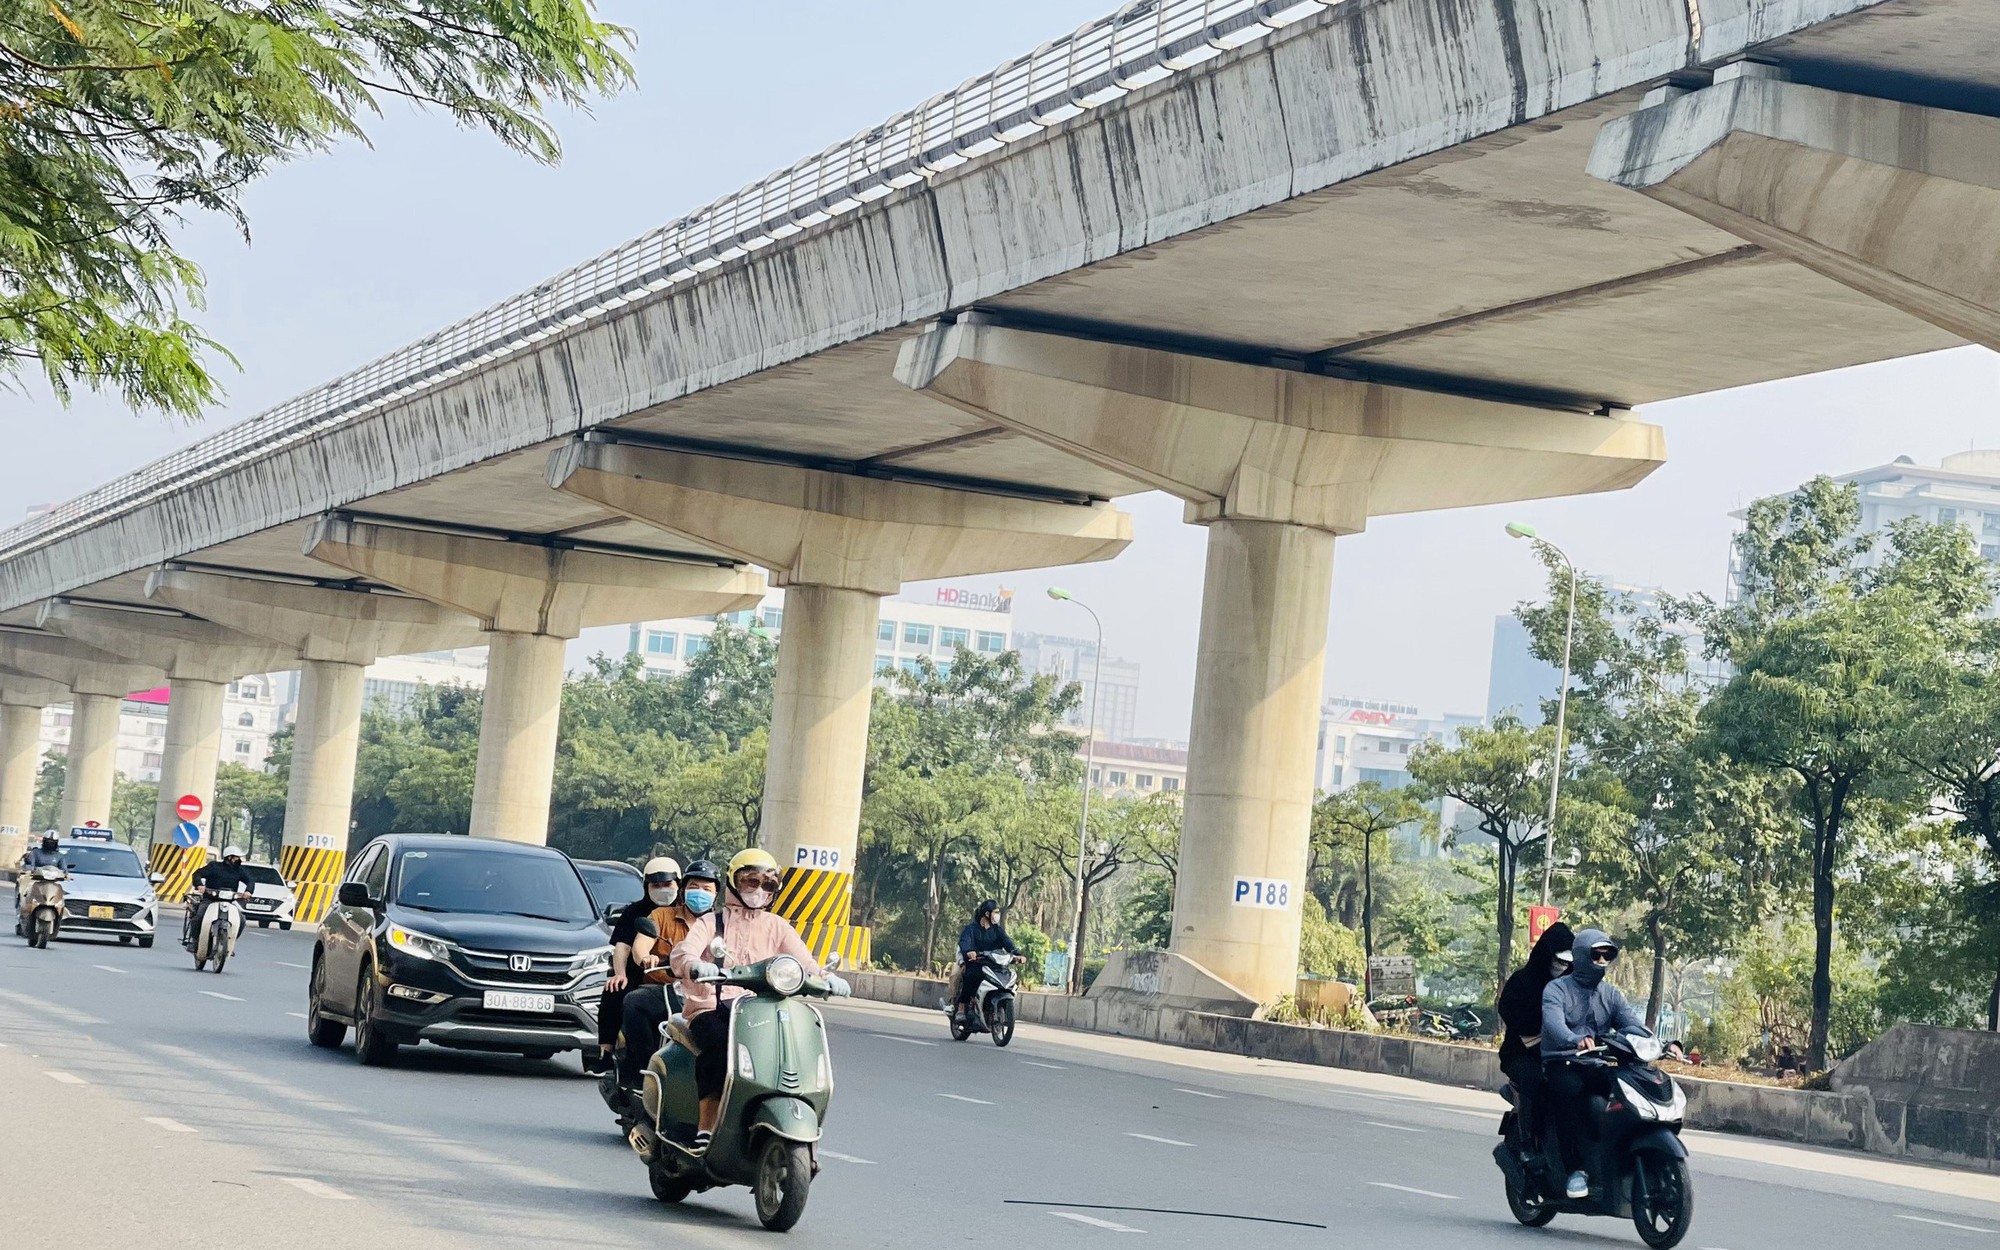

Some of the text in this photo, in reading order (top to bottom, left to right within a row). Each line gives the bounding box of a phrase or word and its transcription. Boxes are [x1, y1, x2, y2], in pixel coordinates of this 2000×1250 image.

[937, 587, 998, 607] HDBank
[307, 835, 334, 848] P191
[797, 848, 839, 867] P189
[1235, 880, 1287, 906] P188
